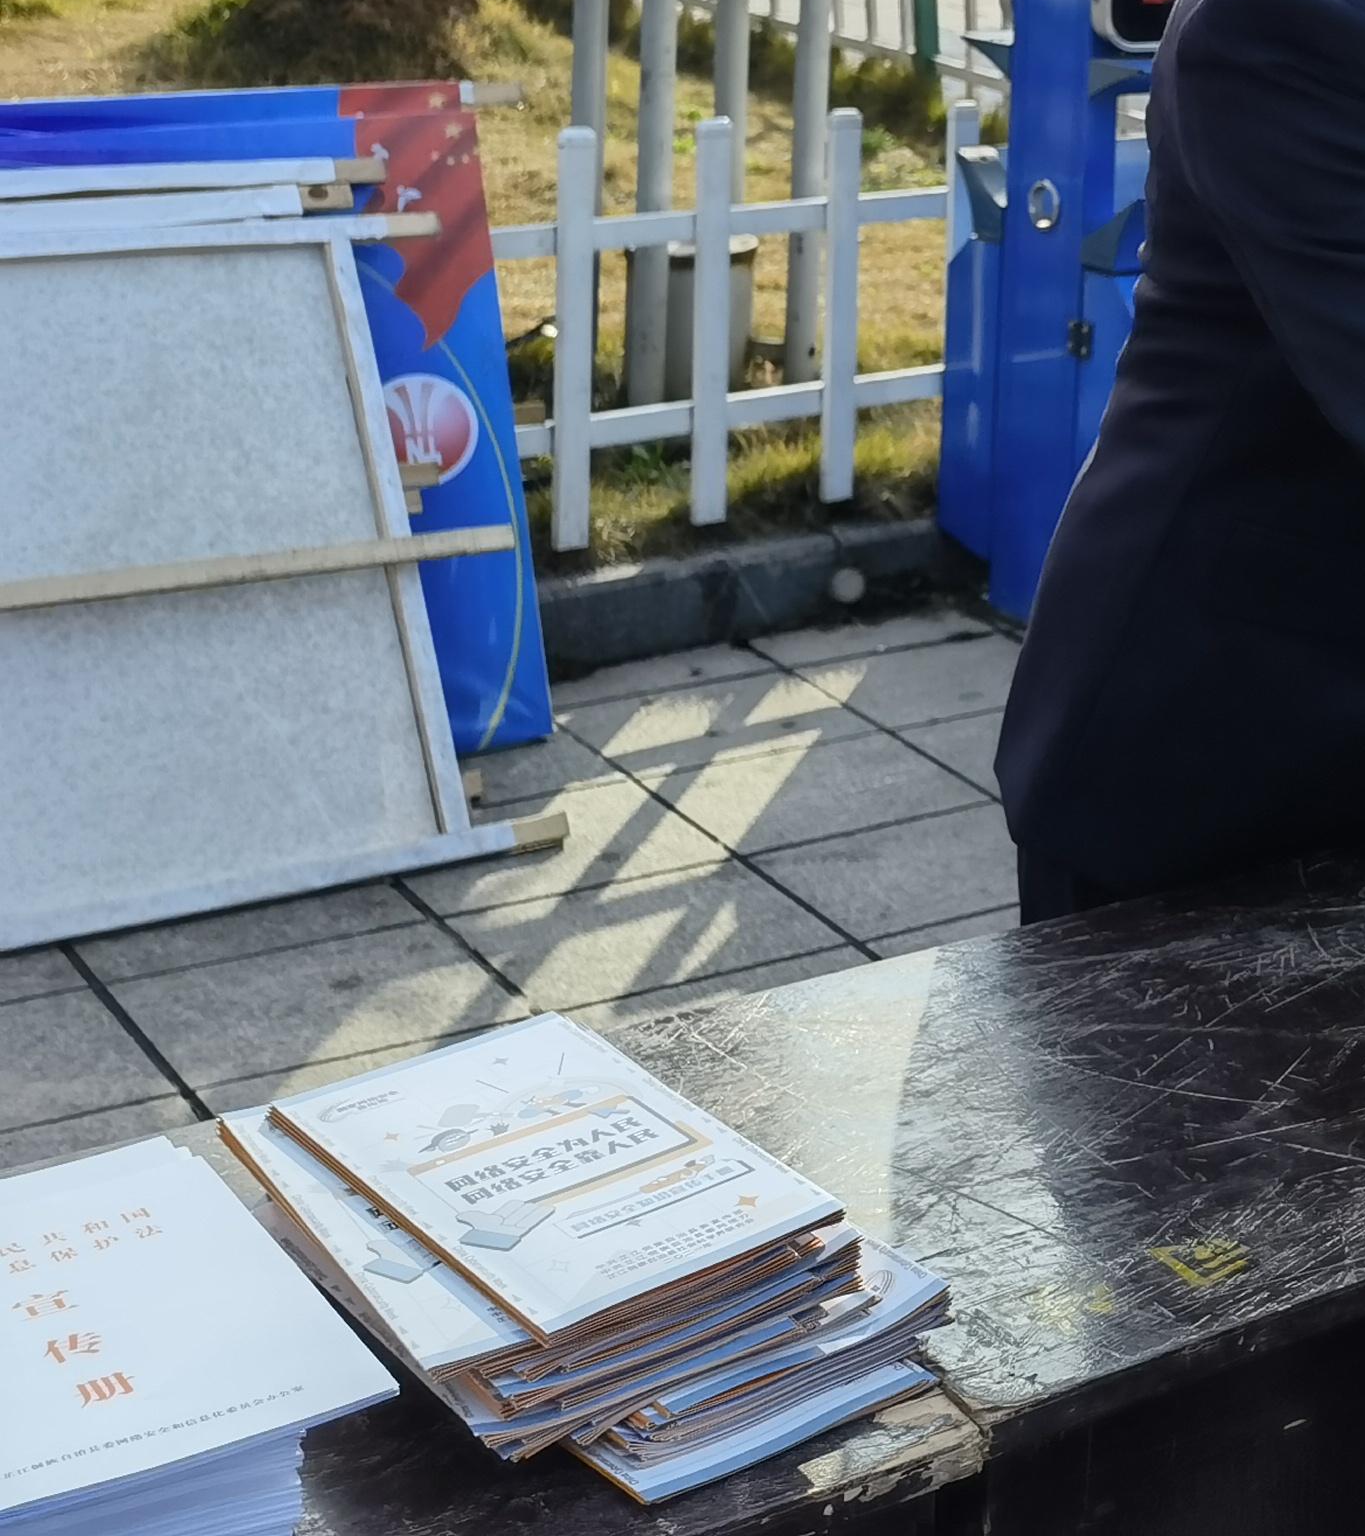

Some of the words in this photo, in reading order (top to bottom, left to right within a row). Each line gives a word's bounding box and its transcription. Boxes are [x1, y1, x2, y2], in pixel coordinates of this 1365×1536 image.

[445, 1116, 643, 1193] 网络安全为人民
[461, 1128, 661, 1206] 网络安全靠人民
